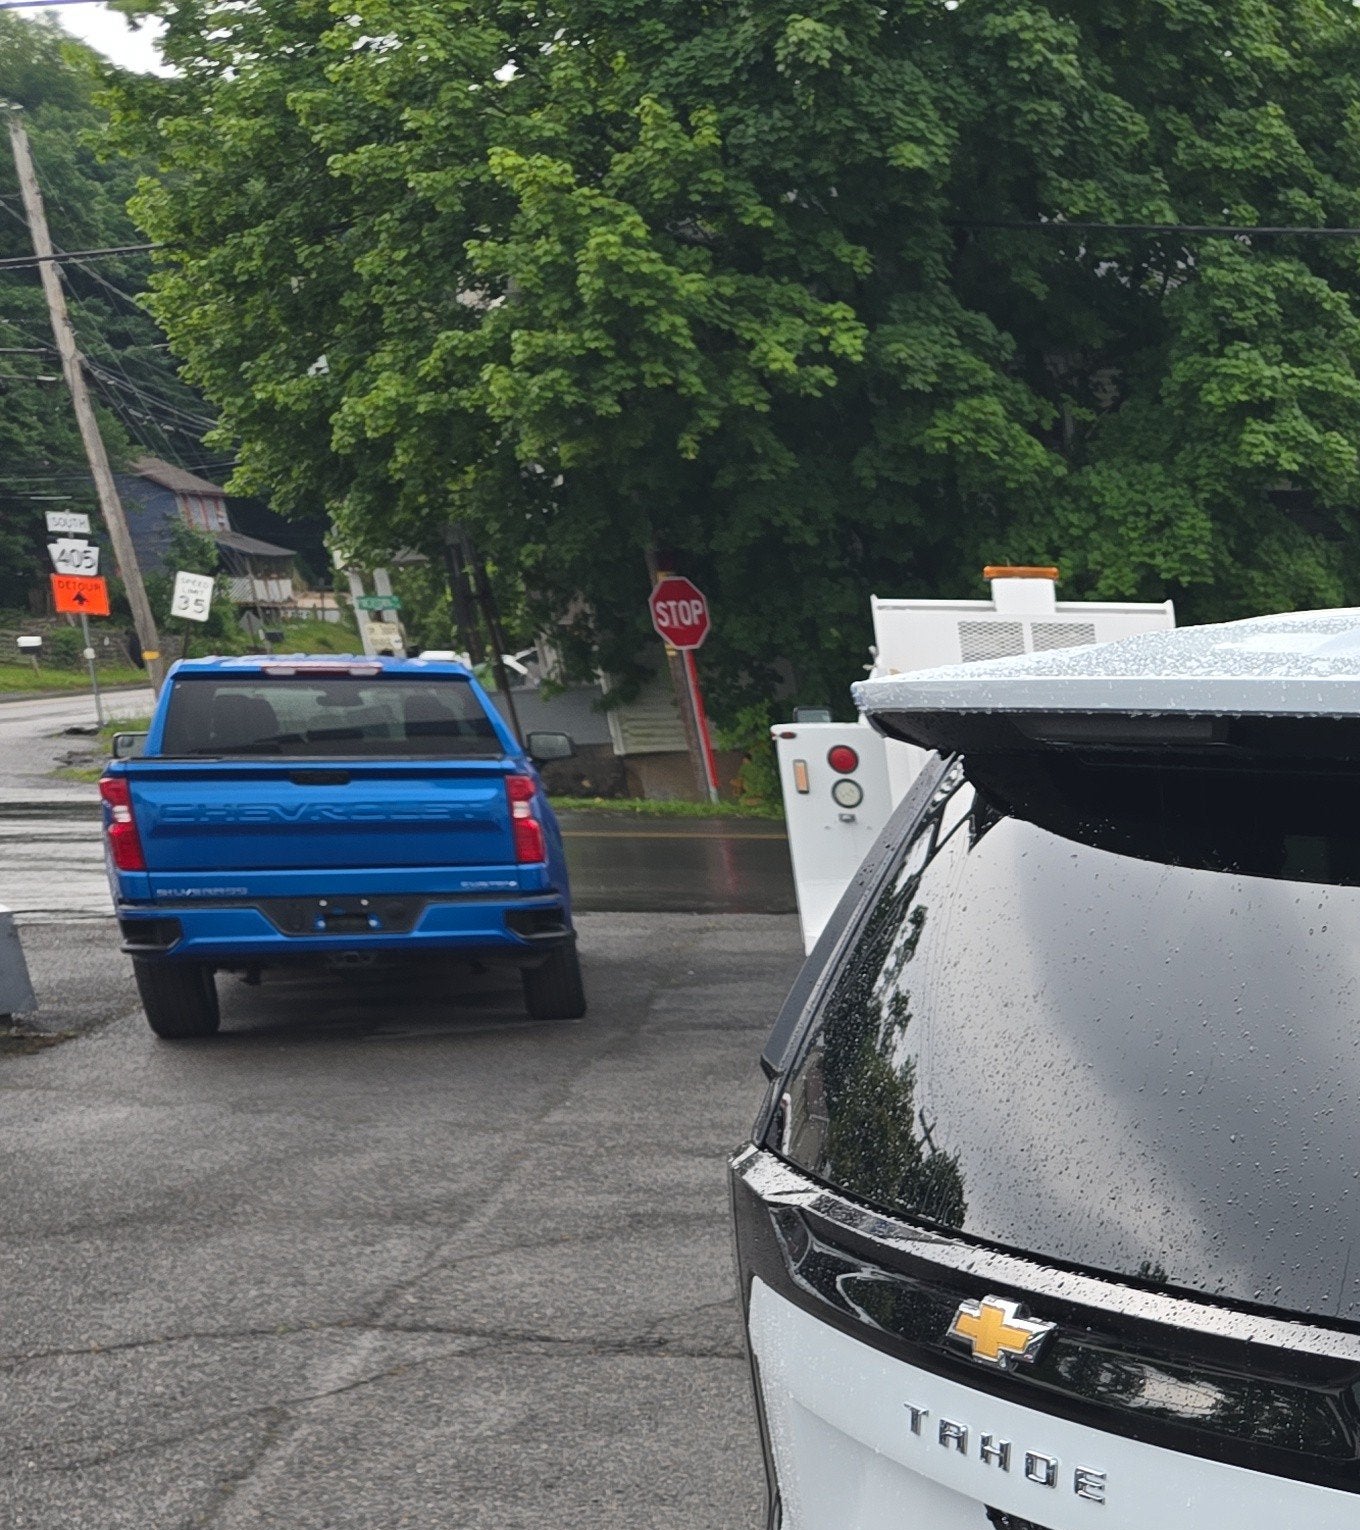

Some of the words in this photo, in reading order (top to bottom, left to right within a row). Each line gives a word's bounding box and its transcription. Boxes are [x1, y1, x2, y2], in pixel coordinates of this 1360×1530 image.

[51, 516, 86, 529] SOUTH
[57, 548, 97, 569] 405
[57, 580, 101, 592] DETOUR
[180, 577, 210, 589] SPEED
[177, 595, 205, 614] 35
[655, 599, 704, 628] STOP
[160, 801, 484, 823] CHEVROLET
[903, 1400, 1108, 1506] TAHOE
